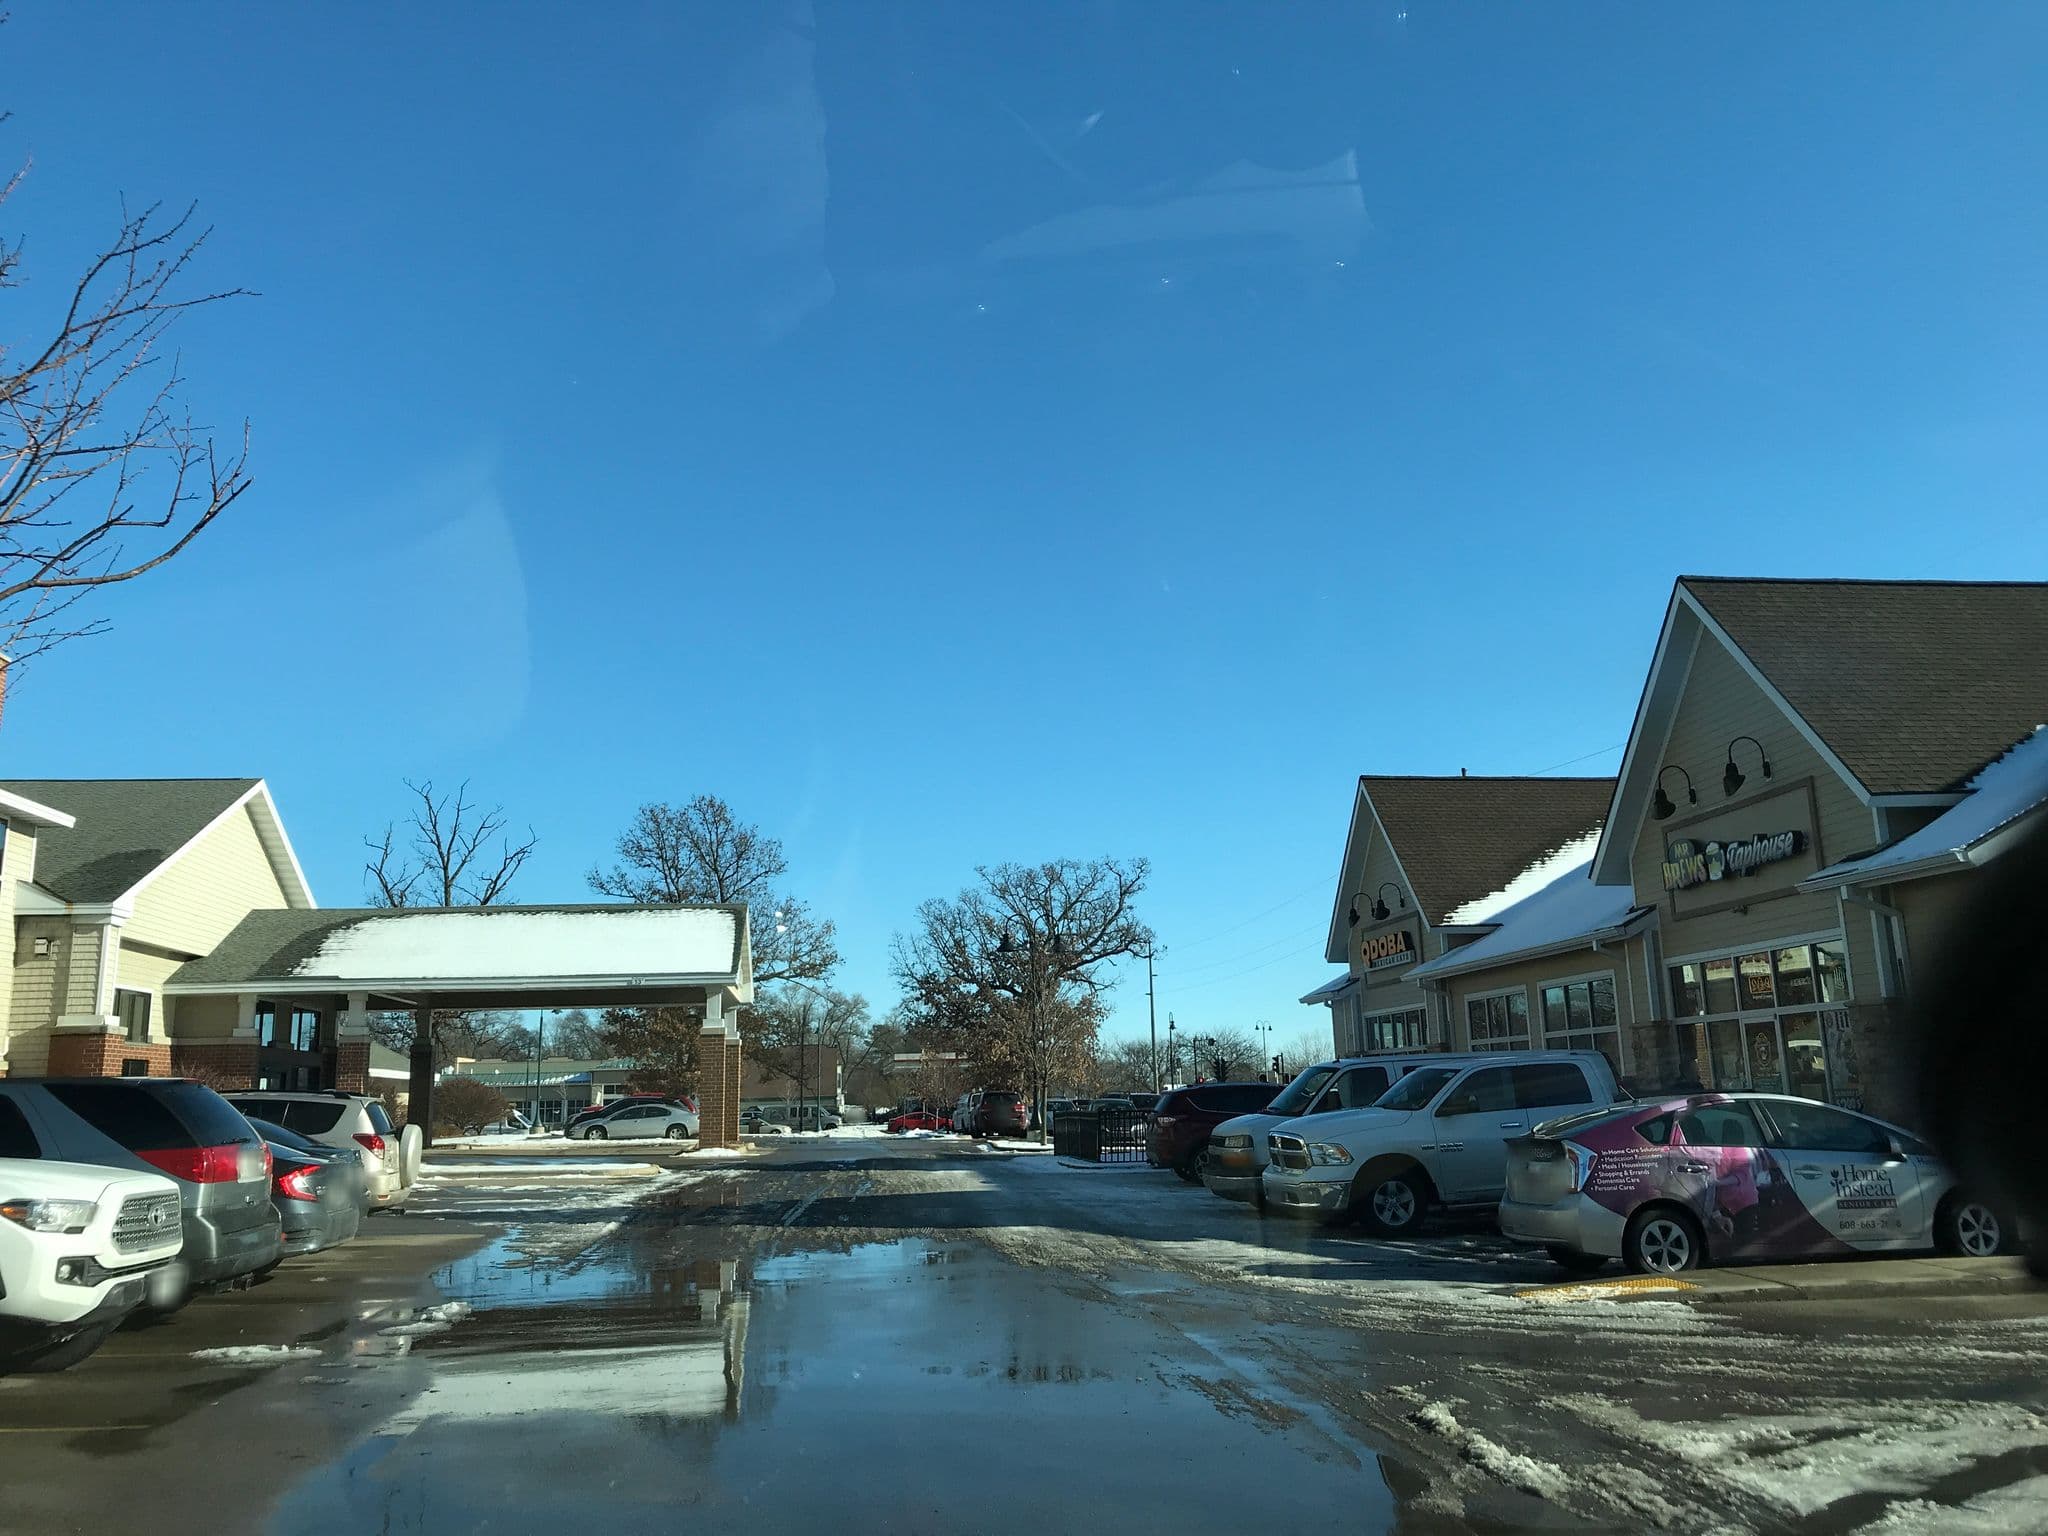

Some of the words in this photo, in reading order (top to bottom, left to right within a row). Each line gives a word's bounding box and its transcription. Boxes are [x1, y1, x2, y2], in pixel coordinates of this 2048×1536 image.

[1726, 831, 1795, 877] Taphouse
[1361, 931, 1406, 968] QDOBA
[1841, 1164, 1887, 1182] Home
[1835, 1178, 1895, 1197] Instead
[1839, 1220, 1902, 1229] 608-663-
